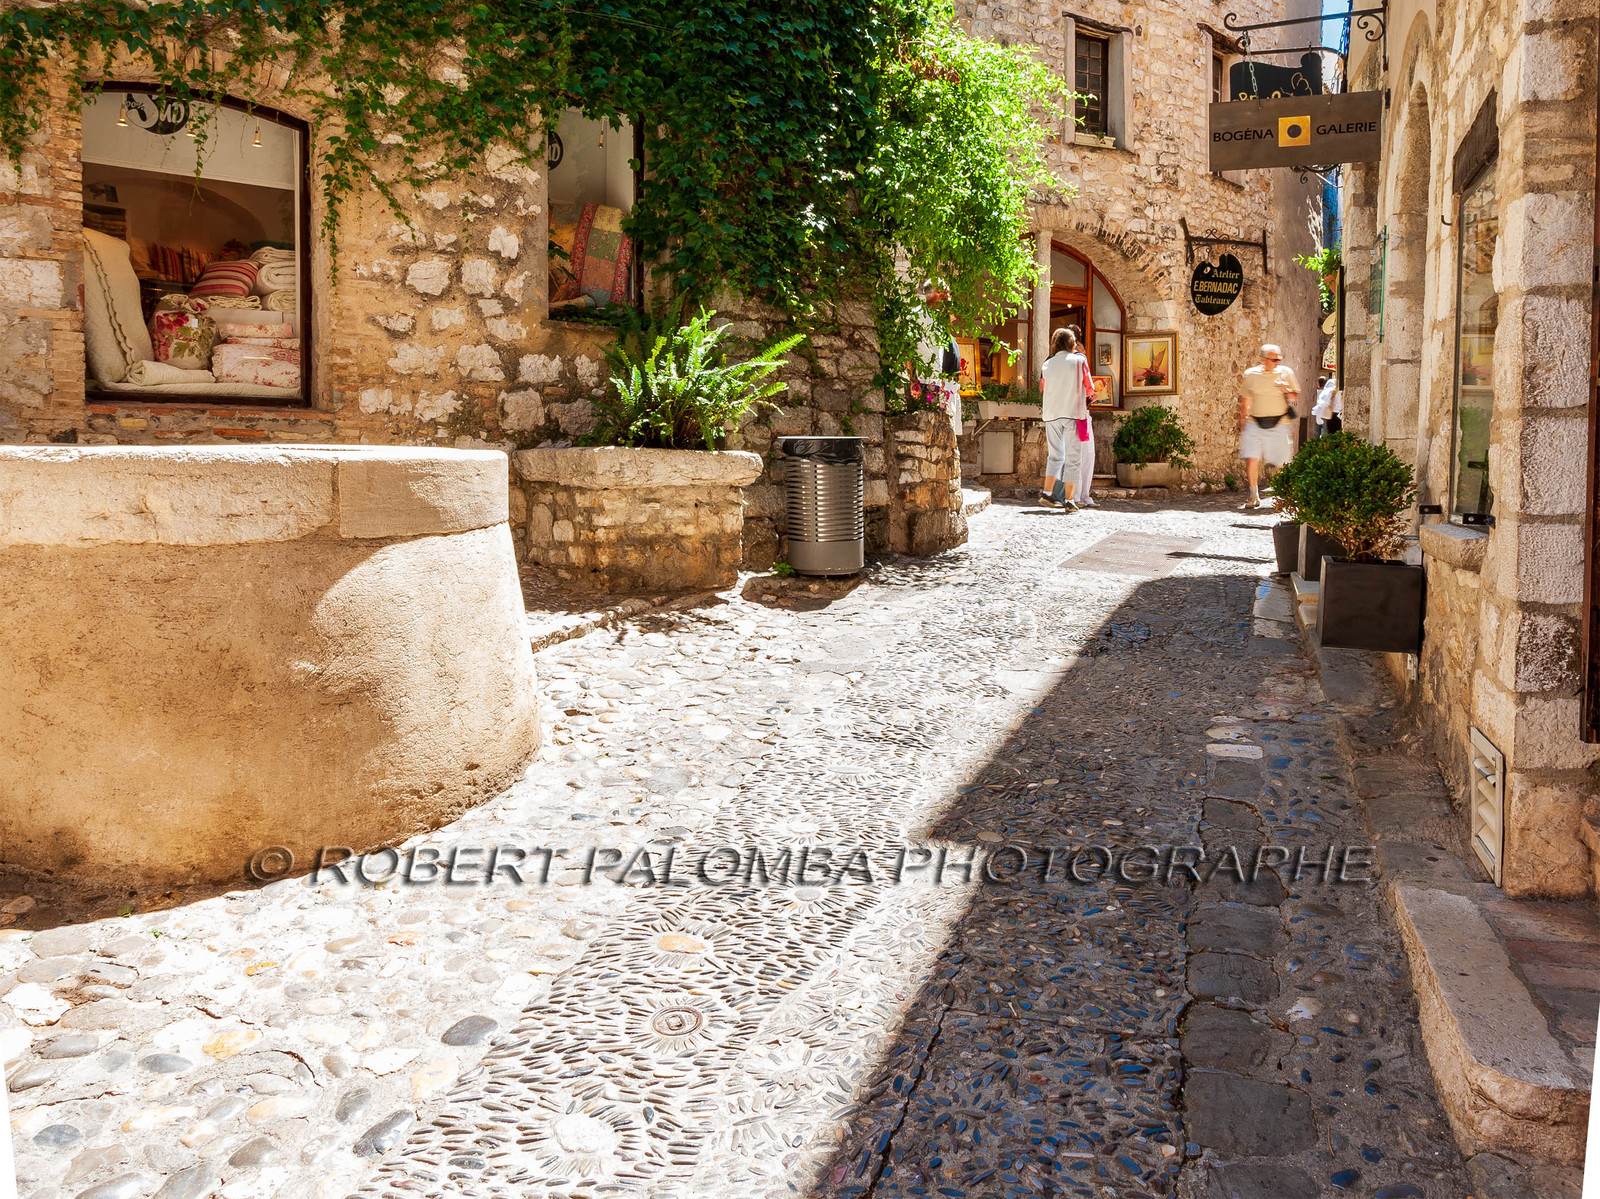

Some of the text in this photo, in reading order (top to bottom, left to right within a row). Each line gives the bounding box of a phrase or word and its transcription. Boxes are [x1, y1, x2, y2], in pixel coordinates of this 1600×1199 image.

[1213, 121, 1377, 142] BOGÉNA GALERIE
[1211, 269, 1240, 278] Atelier
[1194, 294, 1231, 305] Tableaux
